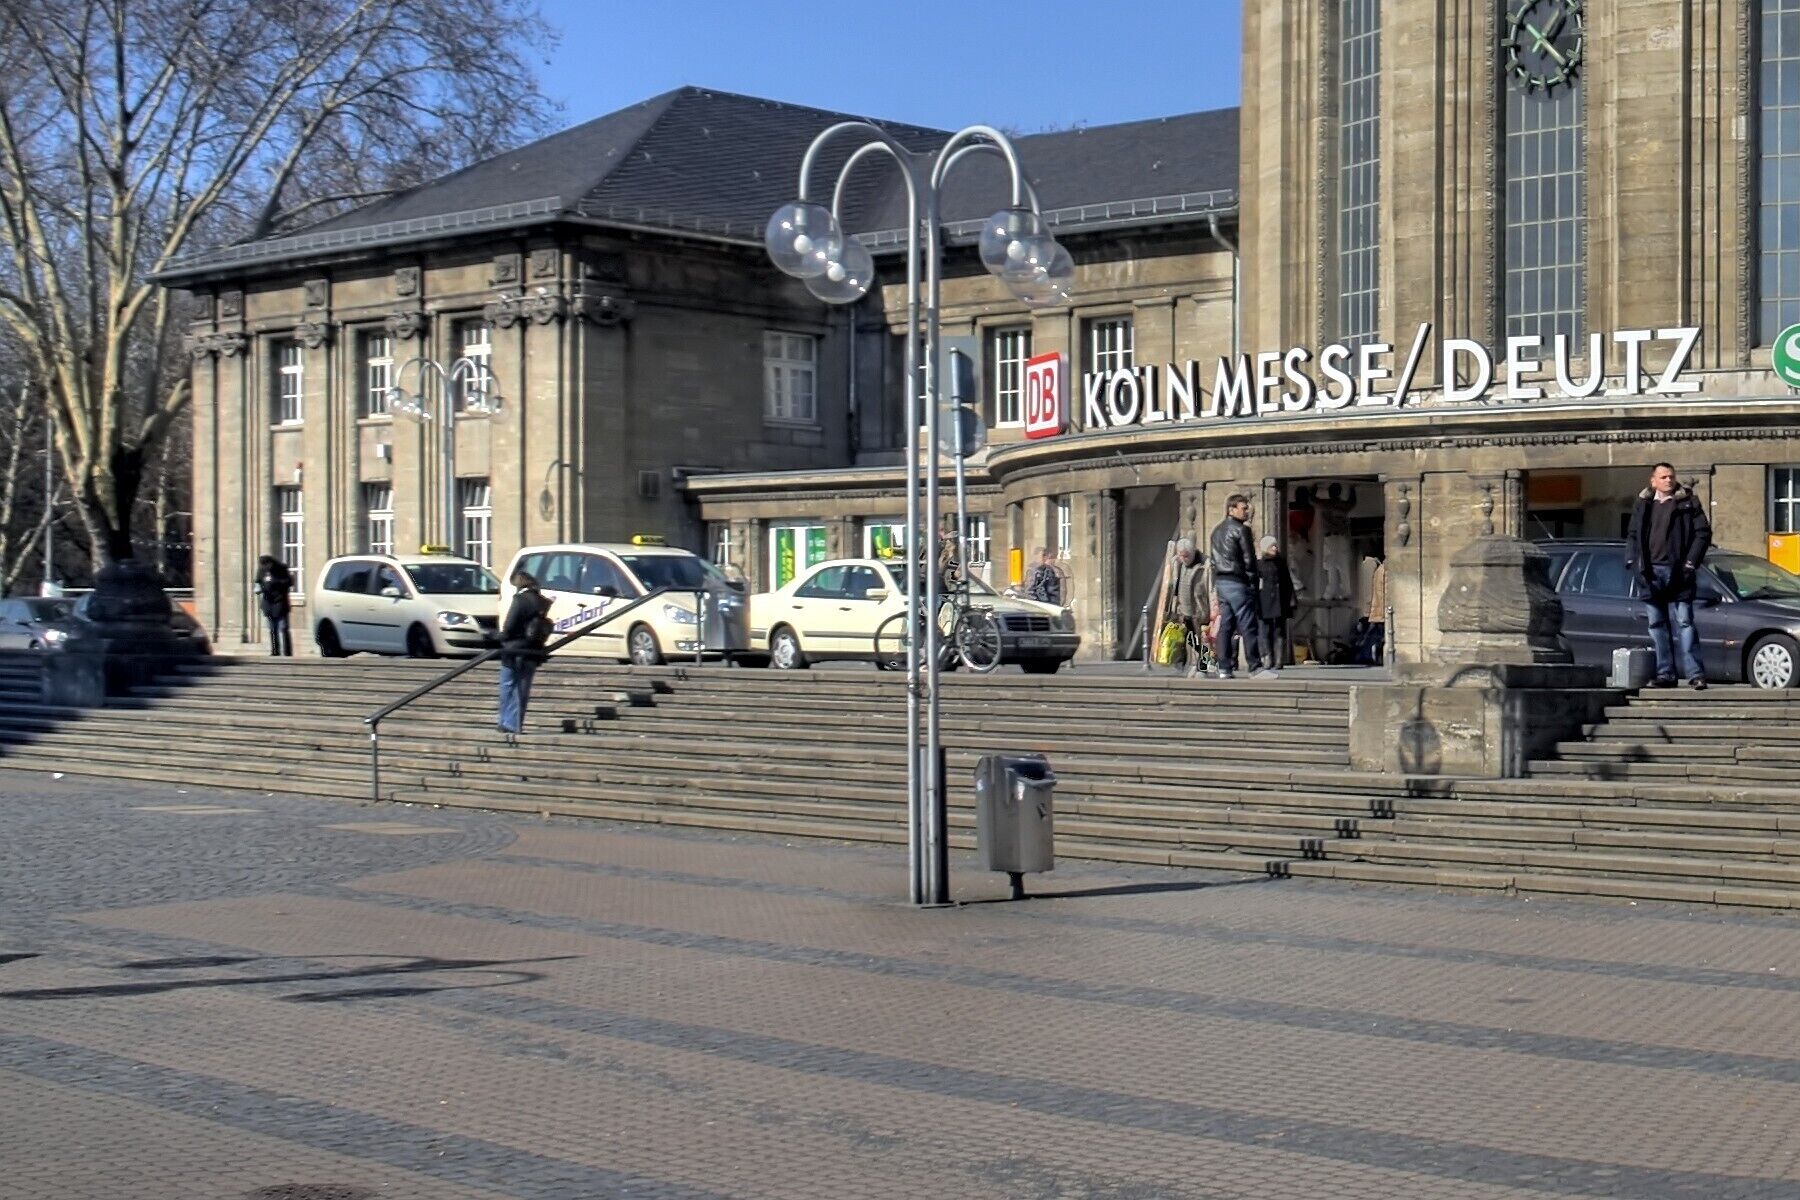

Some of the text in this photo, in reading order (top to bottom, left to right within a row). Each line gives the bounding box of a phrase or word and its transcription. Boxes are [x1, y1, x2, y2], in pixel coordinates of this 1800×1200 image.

[1028, 365, 1059, 426] DB
[1084, 358, 1198, 429] KÖLN
[553, 600, 613, 632] ierdorf
